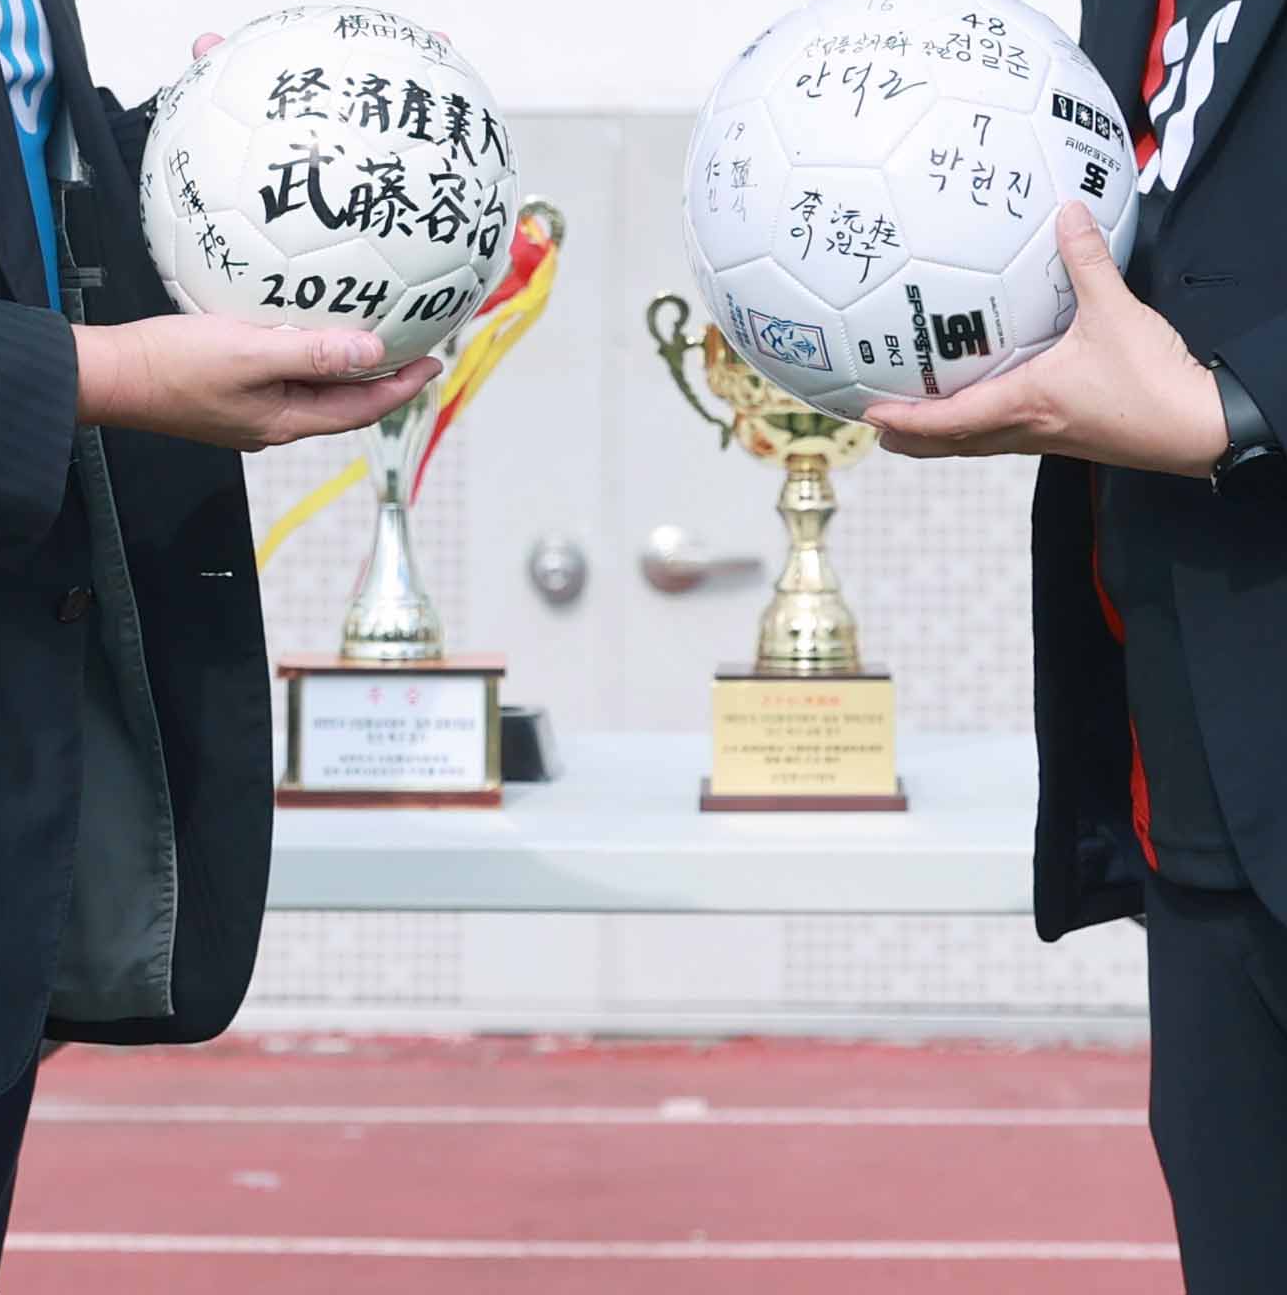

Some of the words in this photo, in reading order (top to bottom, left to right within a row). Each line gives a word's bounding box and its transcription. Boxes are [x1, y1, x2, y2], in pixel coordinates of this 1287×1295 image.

[961, 13, 1006, 37] 48
[972, 113, 992, 145] 7
[929, 147, 1033, 219] 박현진
